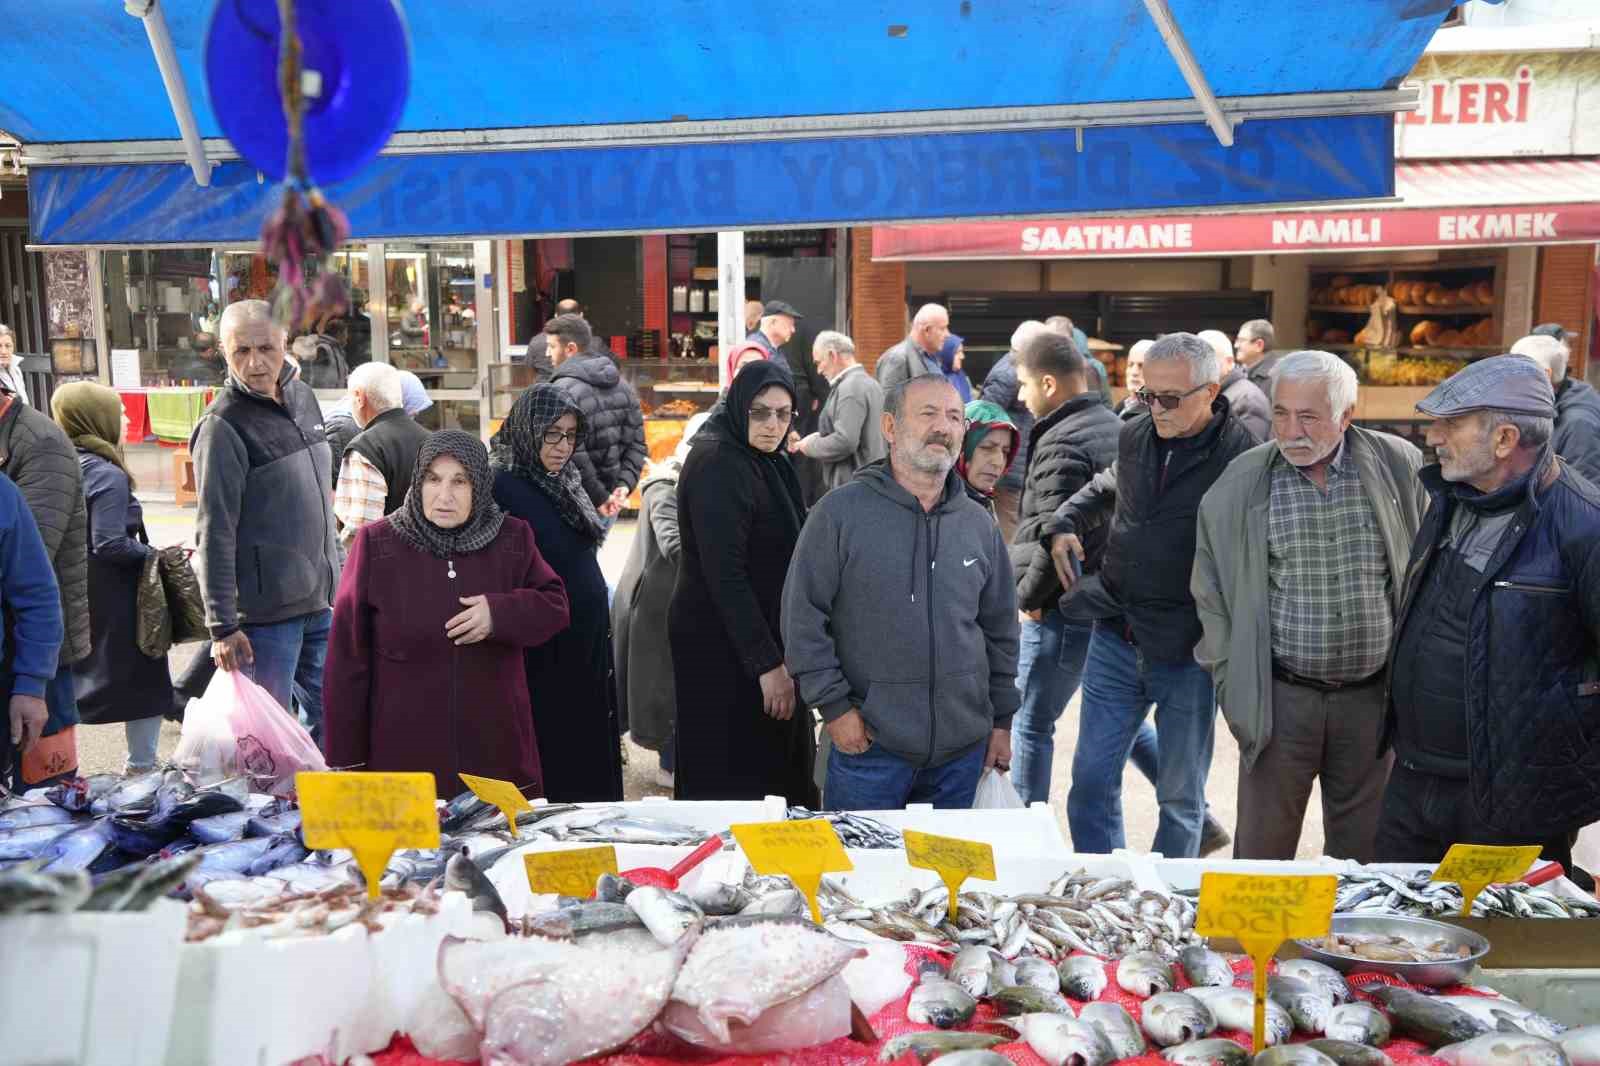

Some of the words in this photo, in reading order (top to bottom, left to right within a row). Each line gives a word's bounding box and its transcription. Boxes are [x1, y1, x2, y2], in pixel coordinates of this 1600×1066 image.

[1021, 223, 1193, 251] SAATHANE
[1272, 217, 1381, 244] NAMLI
[1438, 212, 1558, 241] EKMEK
